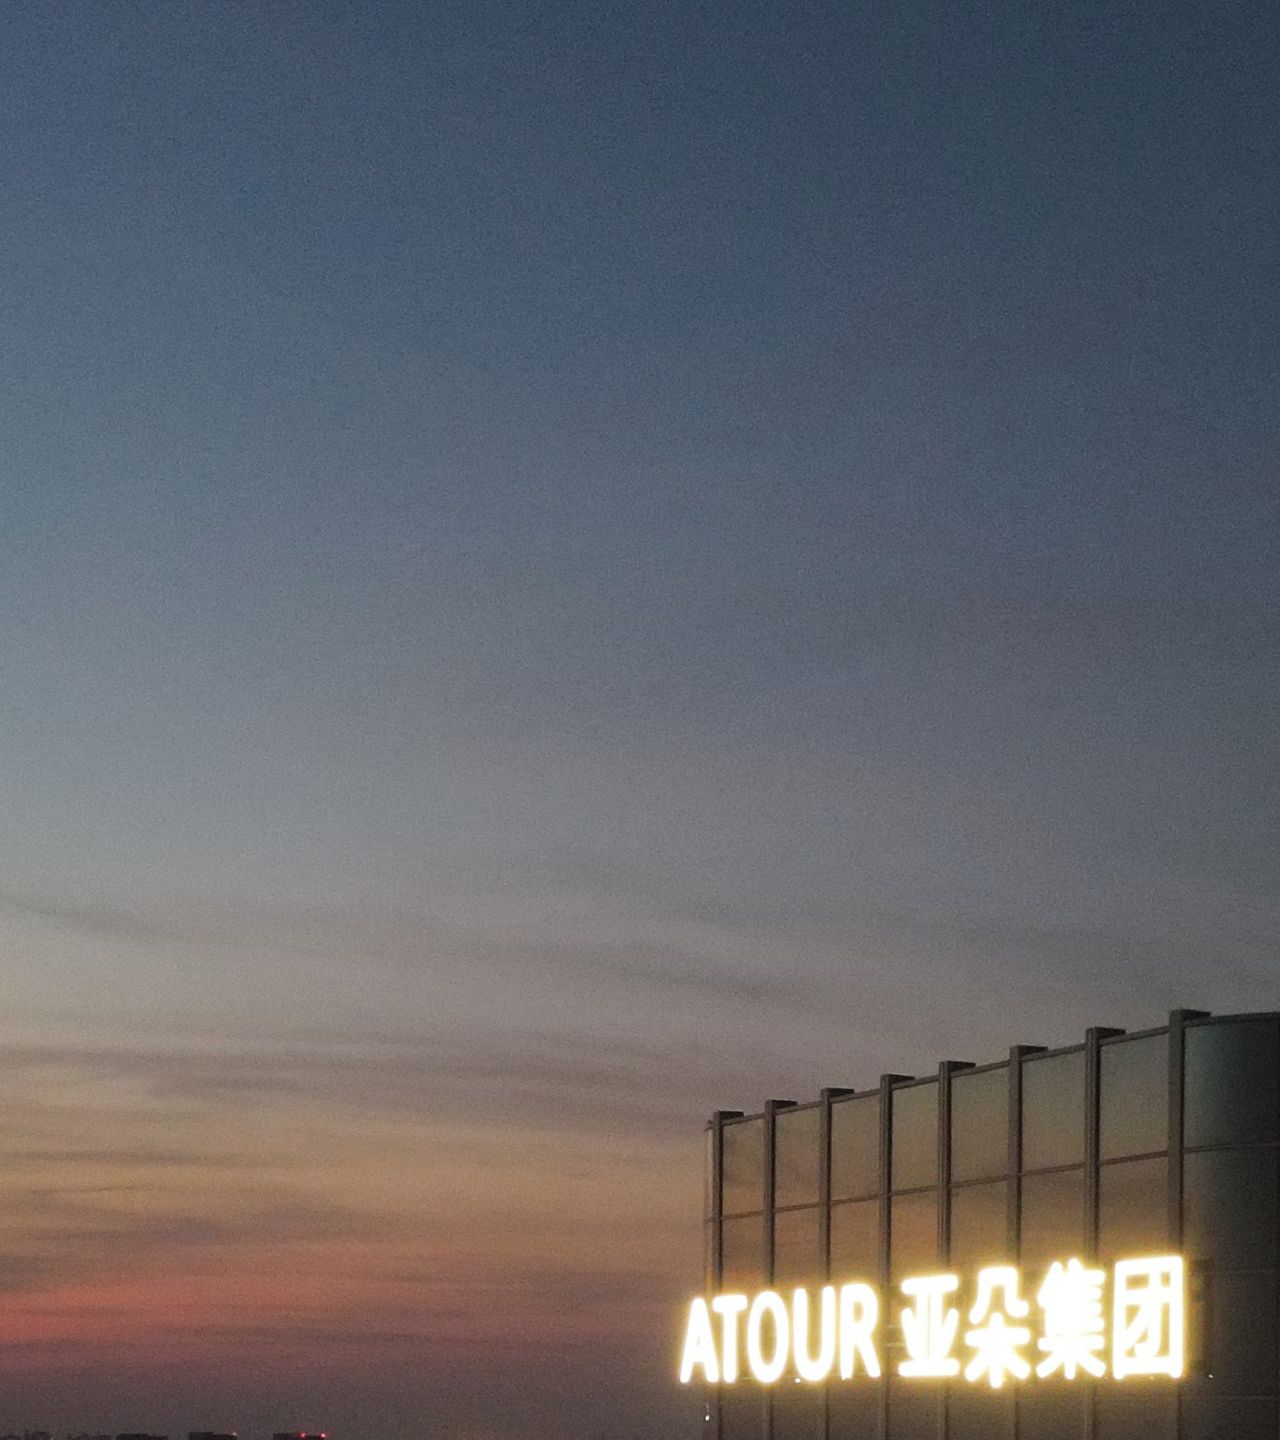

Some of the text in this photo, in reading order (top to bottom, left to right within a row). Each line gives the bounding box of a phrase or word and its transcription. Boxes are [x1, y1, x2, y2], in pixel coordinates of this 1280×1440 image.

[679, 1284, 881, 1384] ATOUR
[898, 1255, 1184, 1389] 亚朵集团
